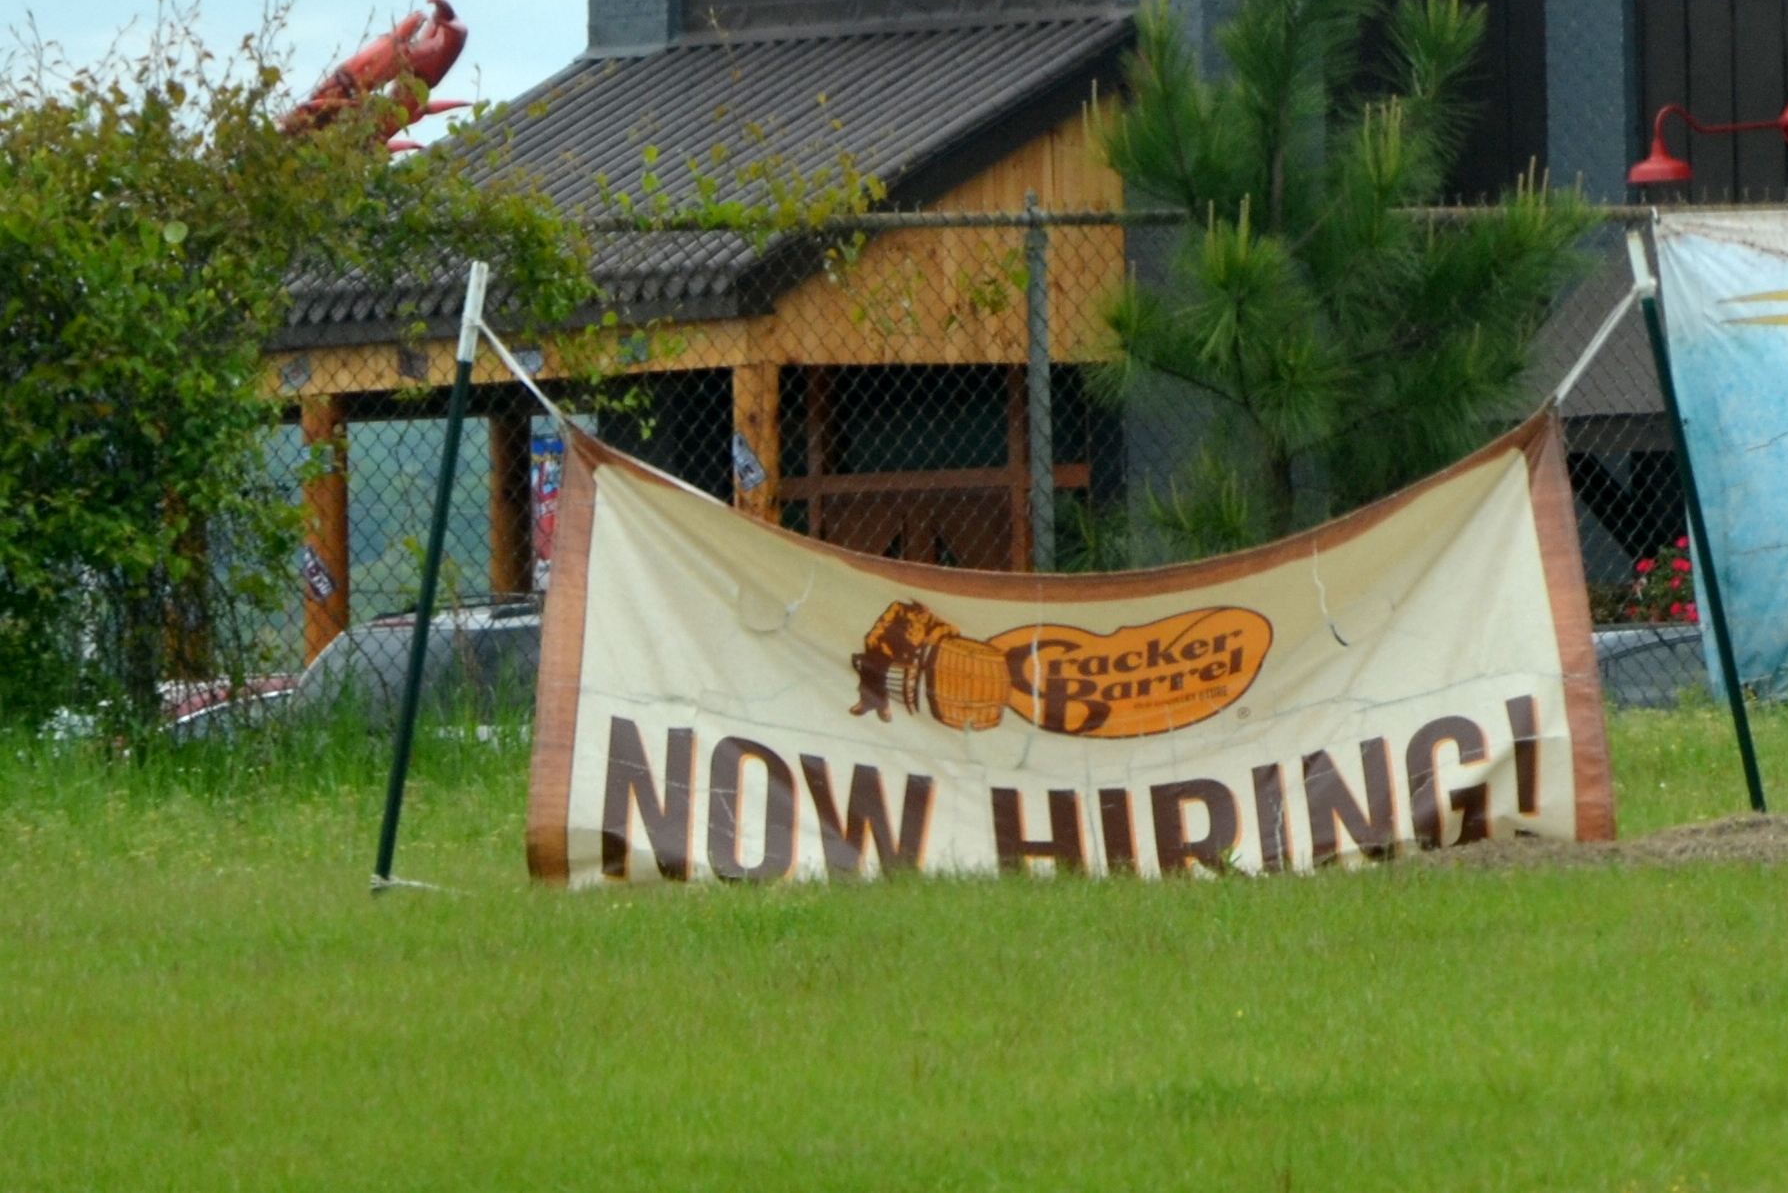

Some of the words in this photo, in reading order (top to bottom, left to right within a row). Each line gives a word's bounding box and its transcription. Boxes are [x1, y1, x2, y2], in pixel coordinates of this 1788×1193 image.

[1004, 629, 1244, 699] Cracker
[1042, 646, 1245, 734] Barrel
[601, 715, 939, 884] NOW
[990, 694, 1541, 878] HIRING!
